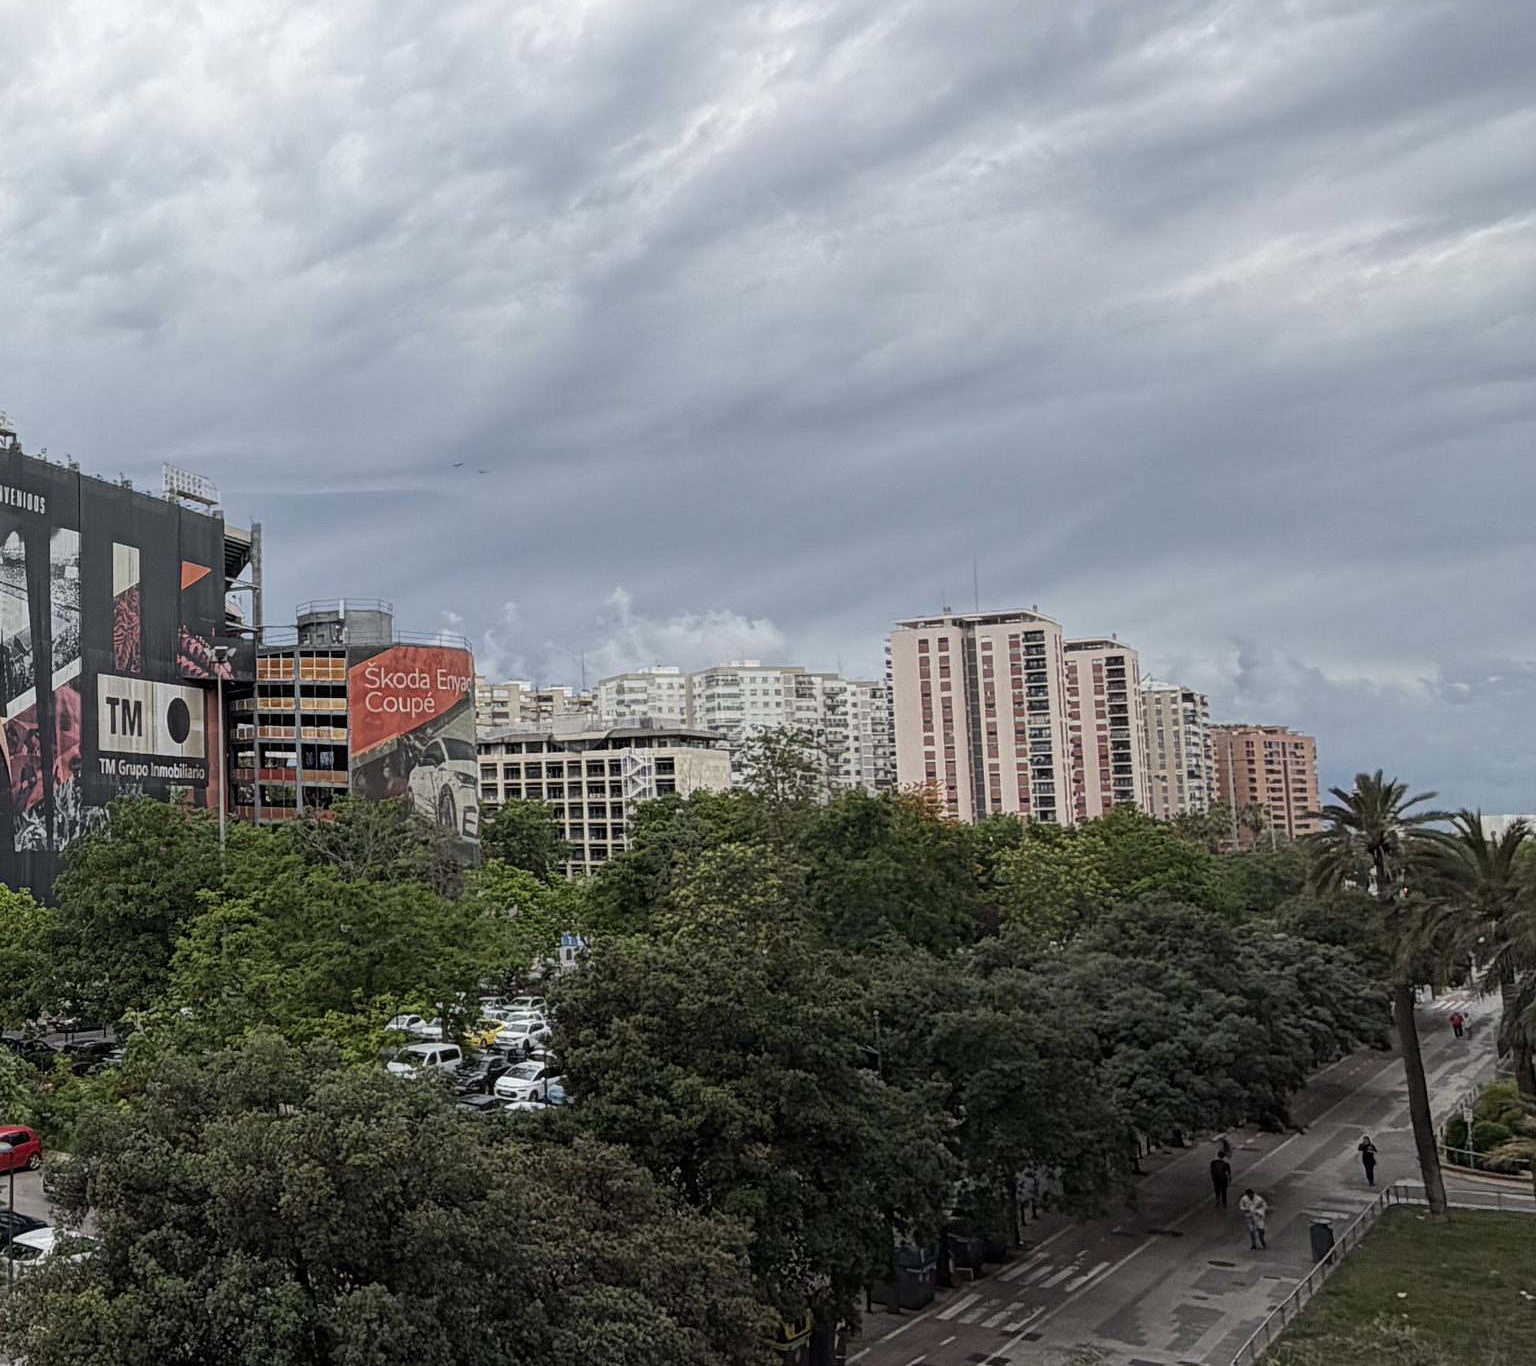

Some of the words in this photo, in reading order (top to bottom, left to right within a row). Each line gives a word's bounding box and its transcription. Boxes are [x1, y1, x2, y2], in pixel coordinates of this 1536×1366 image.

[365, 662, 430, 690] Škoda
[106, 697, 142, 737] TM
[364, 692, 435, 718] Coupé
[99, 758, 115, 775] TM
[118, 760, 148, 781] Grupo
[151, 762, 205, 779] Inmobiliario
